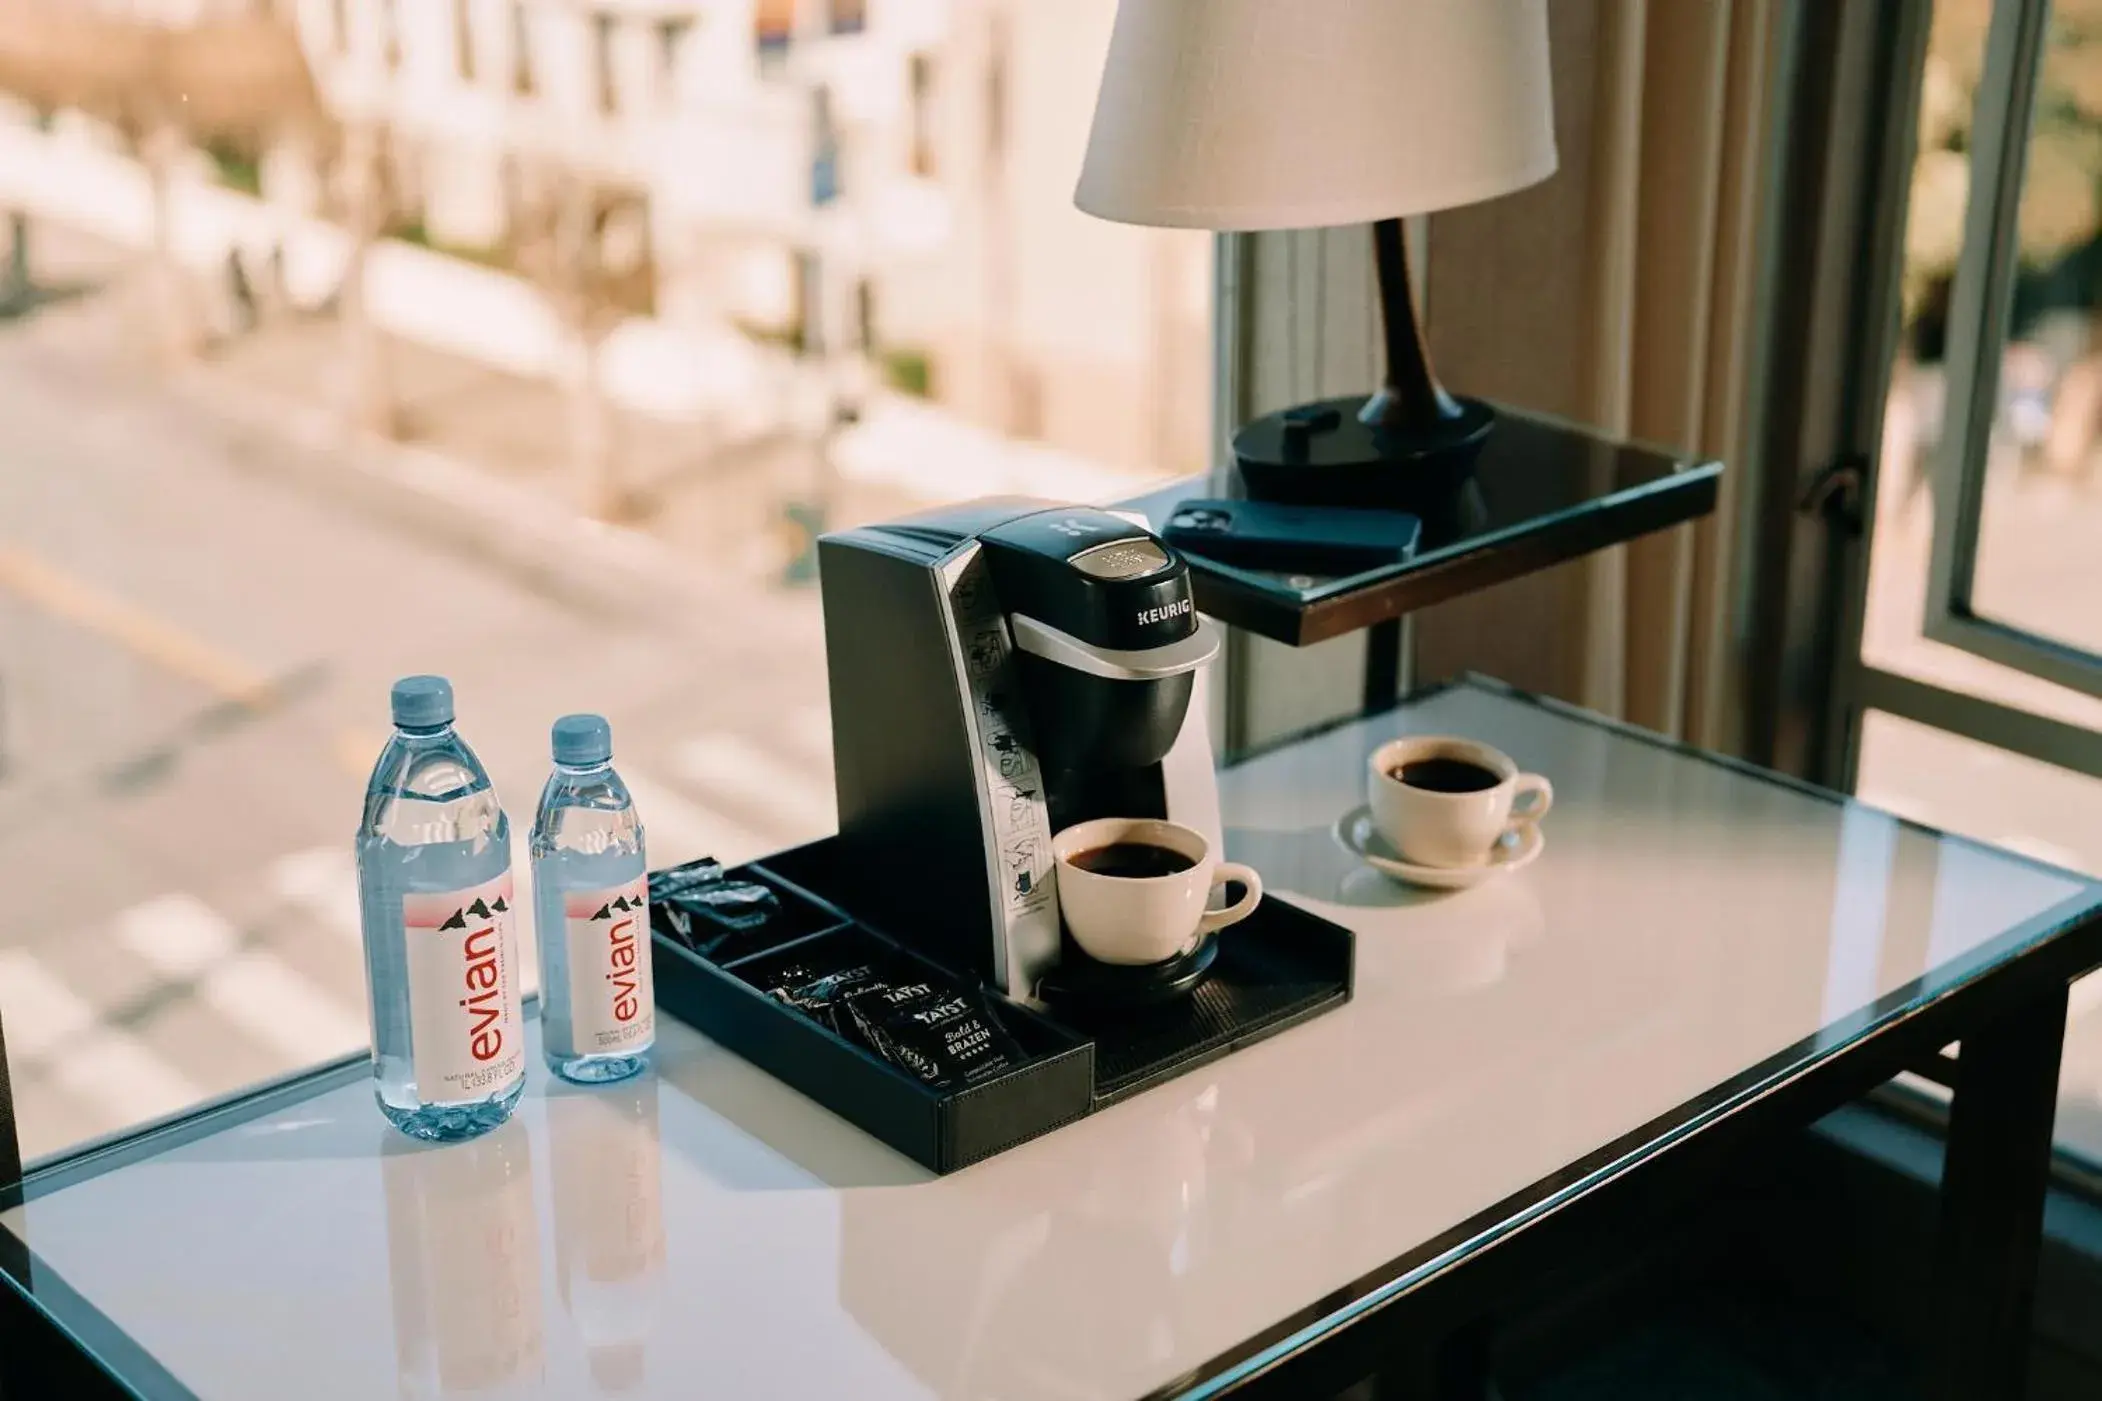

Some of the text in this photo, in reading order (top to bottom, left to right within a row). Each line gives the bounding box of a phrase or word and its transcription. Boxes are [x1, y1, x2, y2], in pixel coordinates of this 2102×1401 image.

[1137, 599, 1190, 626] KEURIG
[606, 919, 638, 1022] evian
[459, 926, 503, 1061] evian
[913, 997, 968, 1024] TAYST
[945, 1023, 972, 1043] Bold
[971, 1019, 981, 1030] &
[947, 1028, 991, 1055] BRAZEN
